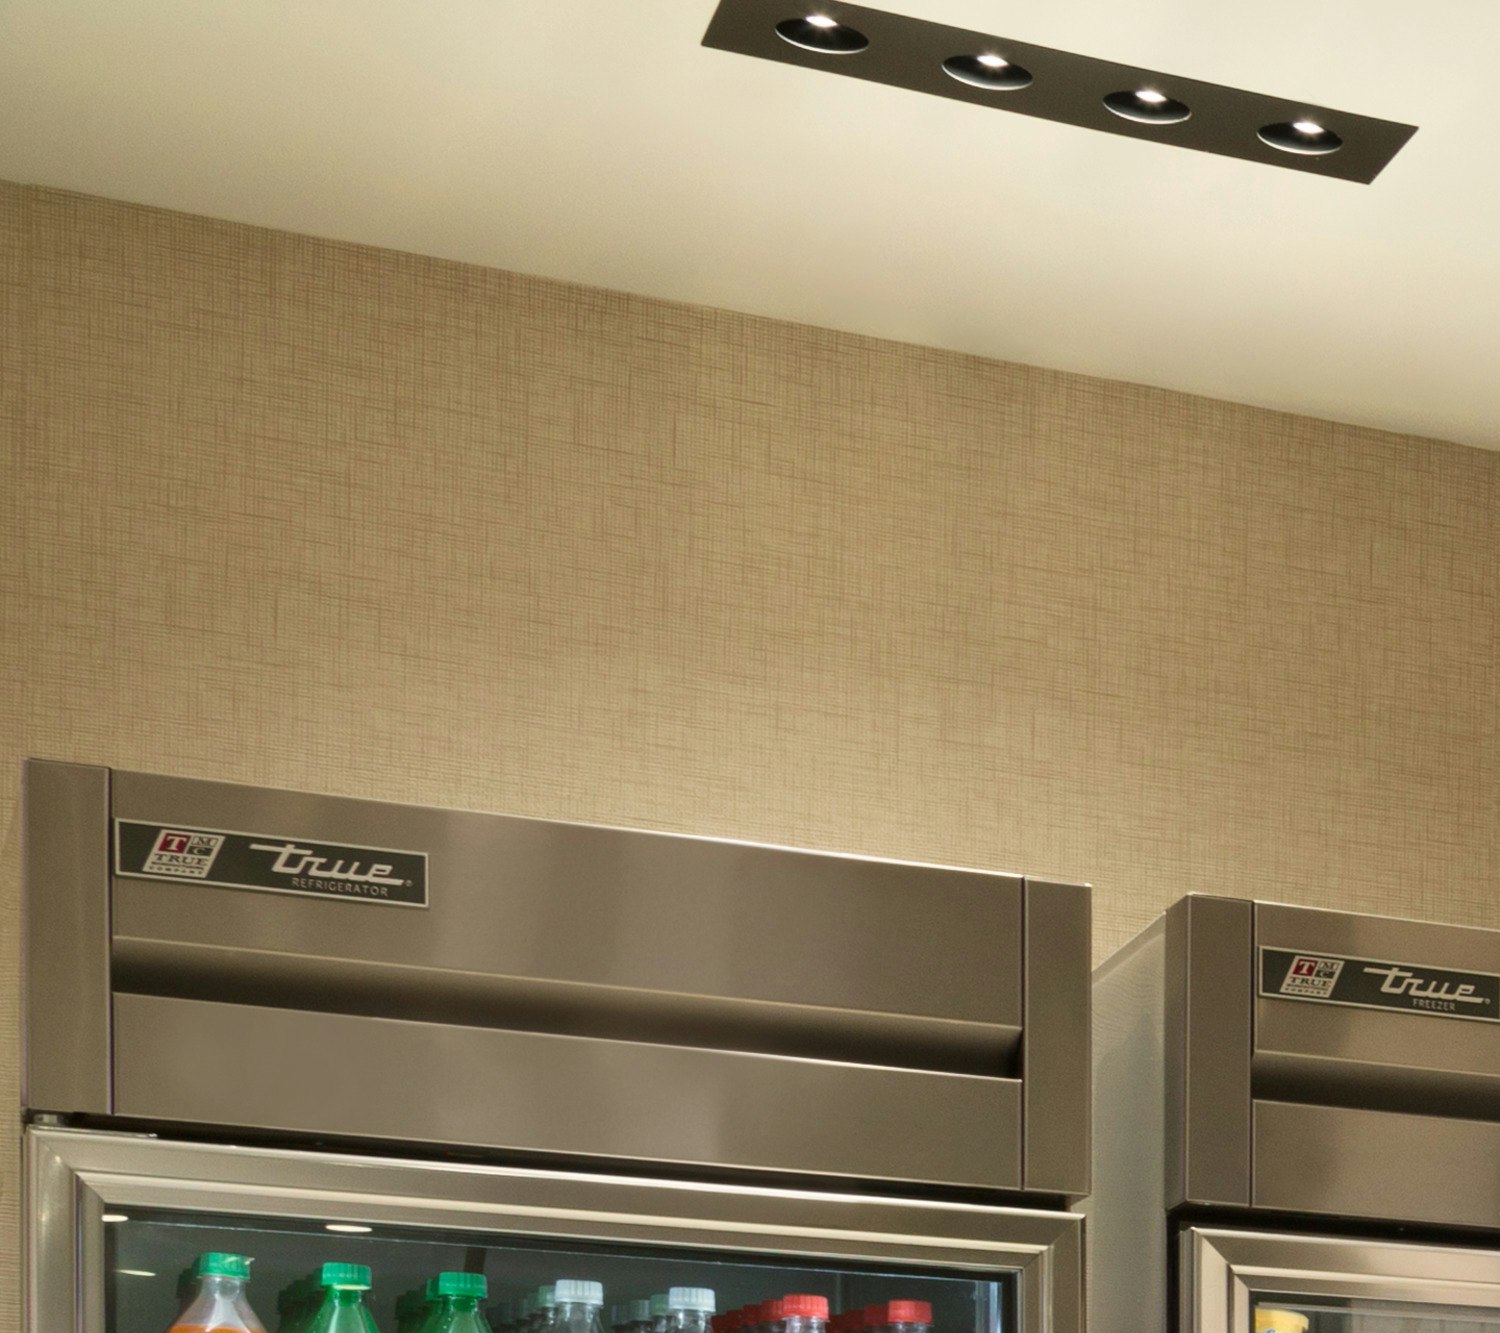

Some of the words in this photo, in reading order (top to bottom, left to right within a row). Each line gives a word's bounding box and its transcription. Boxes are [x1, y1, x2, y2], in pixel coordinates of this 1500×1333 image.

[152, 852, 209, 868] TRUE
[250, 844, 404, 886] true
[292, 877, 388, 897] REFRIGERATOR
[1289, 976, 1332, 988] TRUE
[1363, 967, 1483, 1004] true
[1412, 998, 1456, 1012] FREEZER
